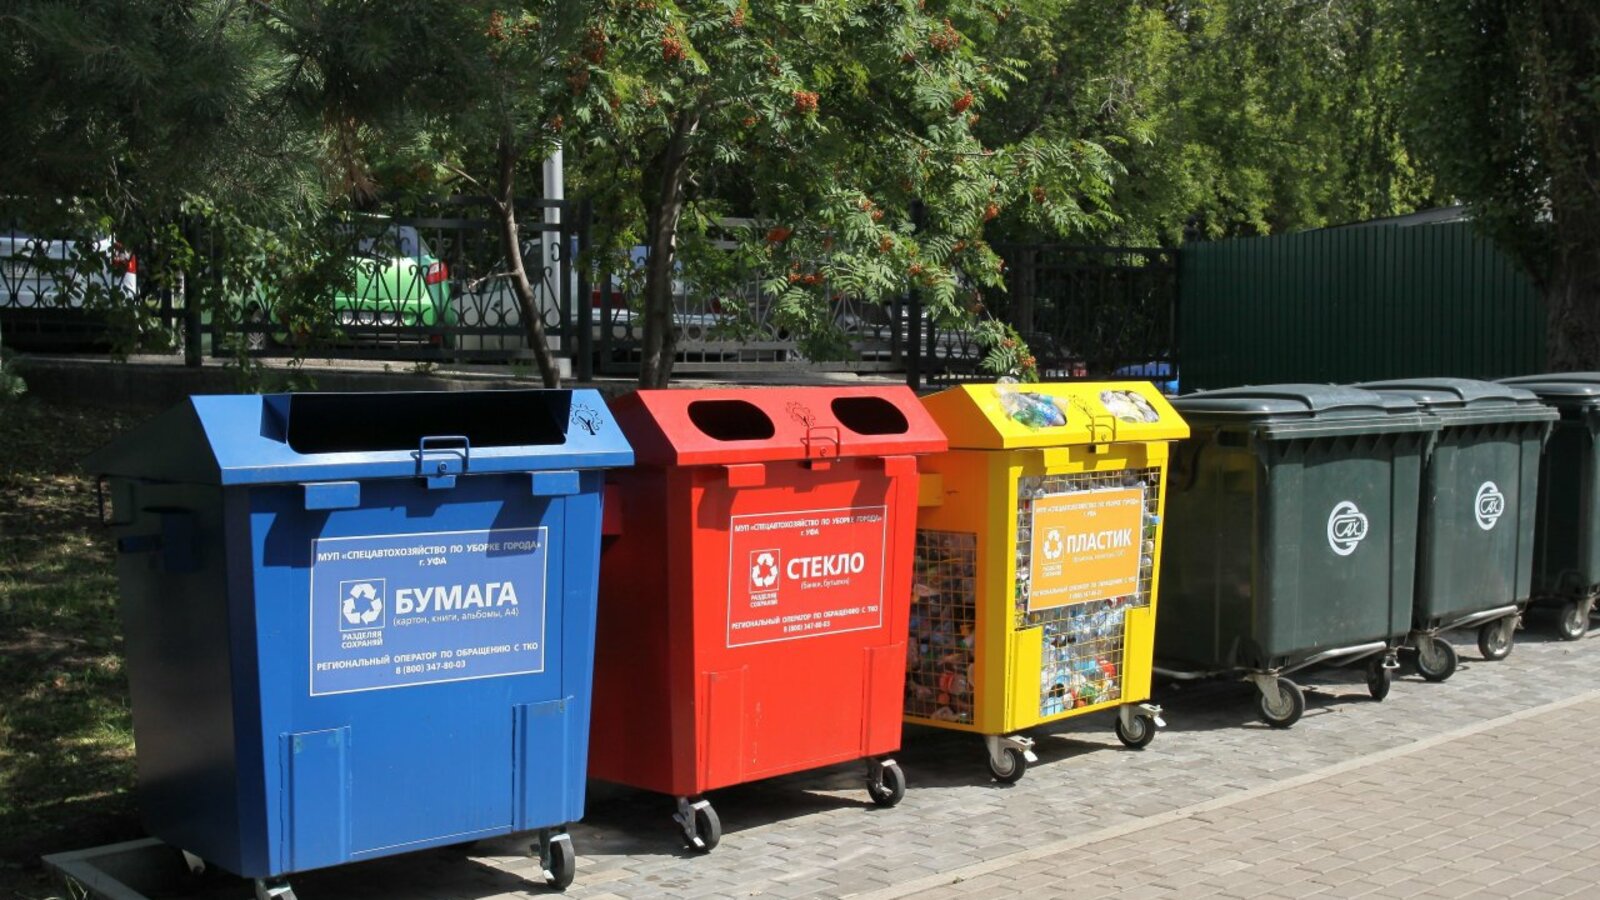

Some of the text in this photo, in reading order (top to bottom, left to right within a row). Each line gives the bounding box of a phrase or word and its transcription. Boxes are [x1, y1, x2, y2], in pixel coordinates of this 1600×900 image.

[806, 528, 819, 536] УФА
[1067, 528, 1132, 553] ПЛАСТИК
[318, 540, 541, 562] МУП «СПЕЦАВТОХОЗЯЙСТВО ПО УБОРКЕ ГОРОДА»
[419, 557, 447, 567] г. УФА
[786, 552, 865, 580] СТЕКЛО
[395, 581, 518, 614] БУМАГА
[393, 608, 520, 627] (картон, книги, альбомы, А4)
[732, 616, 780, 629] РЕГИОНАЛЬНЫЙ
[782, 613, 812, 623] ОПЕРАТОР
[823, 608, 860, 618] ОБРАЩЕНИЮ
[341, 638, 383, 649] СОХРАНЯЙ
[342, 631, 382, 640] РАЗДЕЛЯЯ
[317, 642, 539, 671] РЕГИОНАЛЬНЫЙ ОПЕРАТОР ПО ОБРАЩЕНИЮ С ТКО
[403, 664, 424, 675] (800)
[426, 660, 466, 671] 347-80-03
